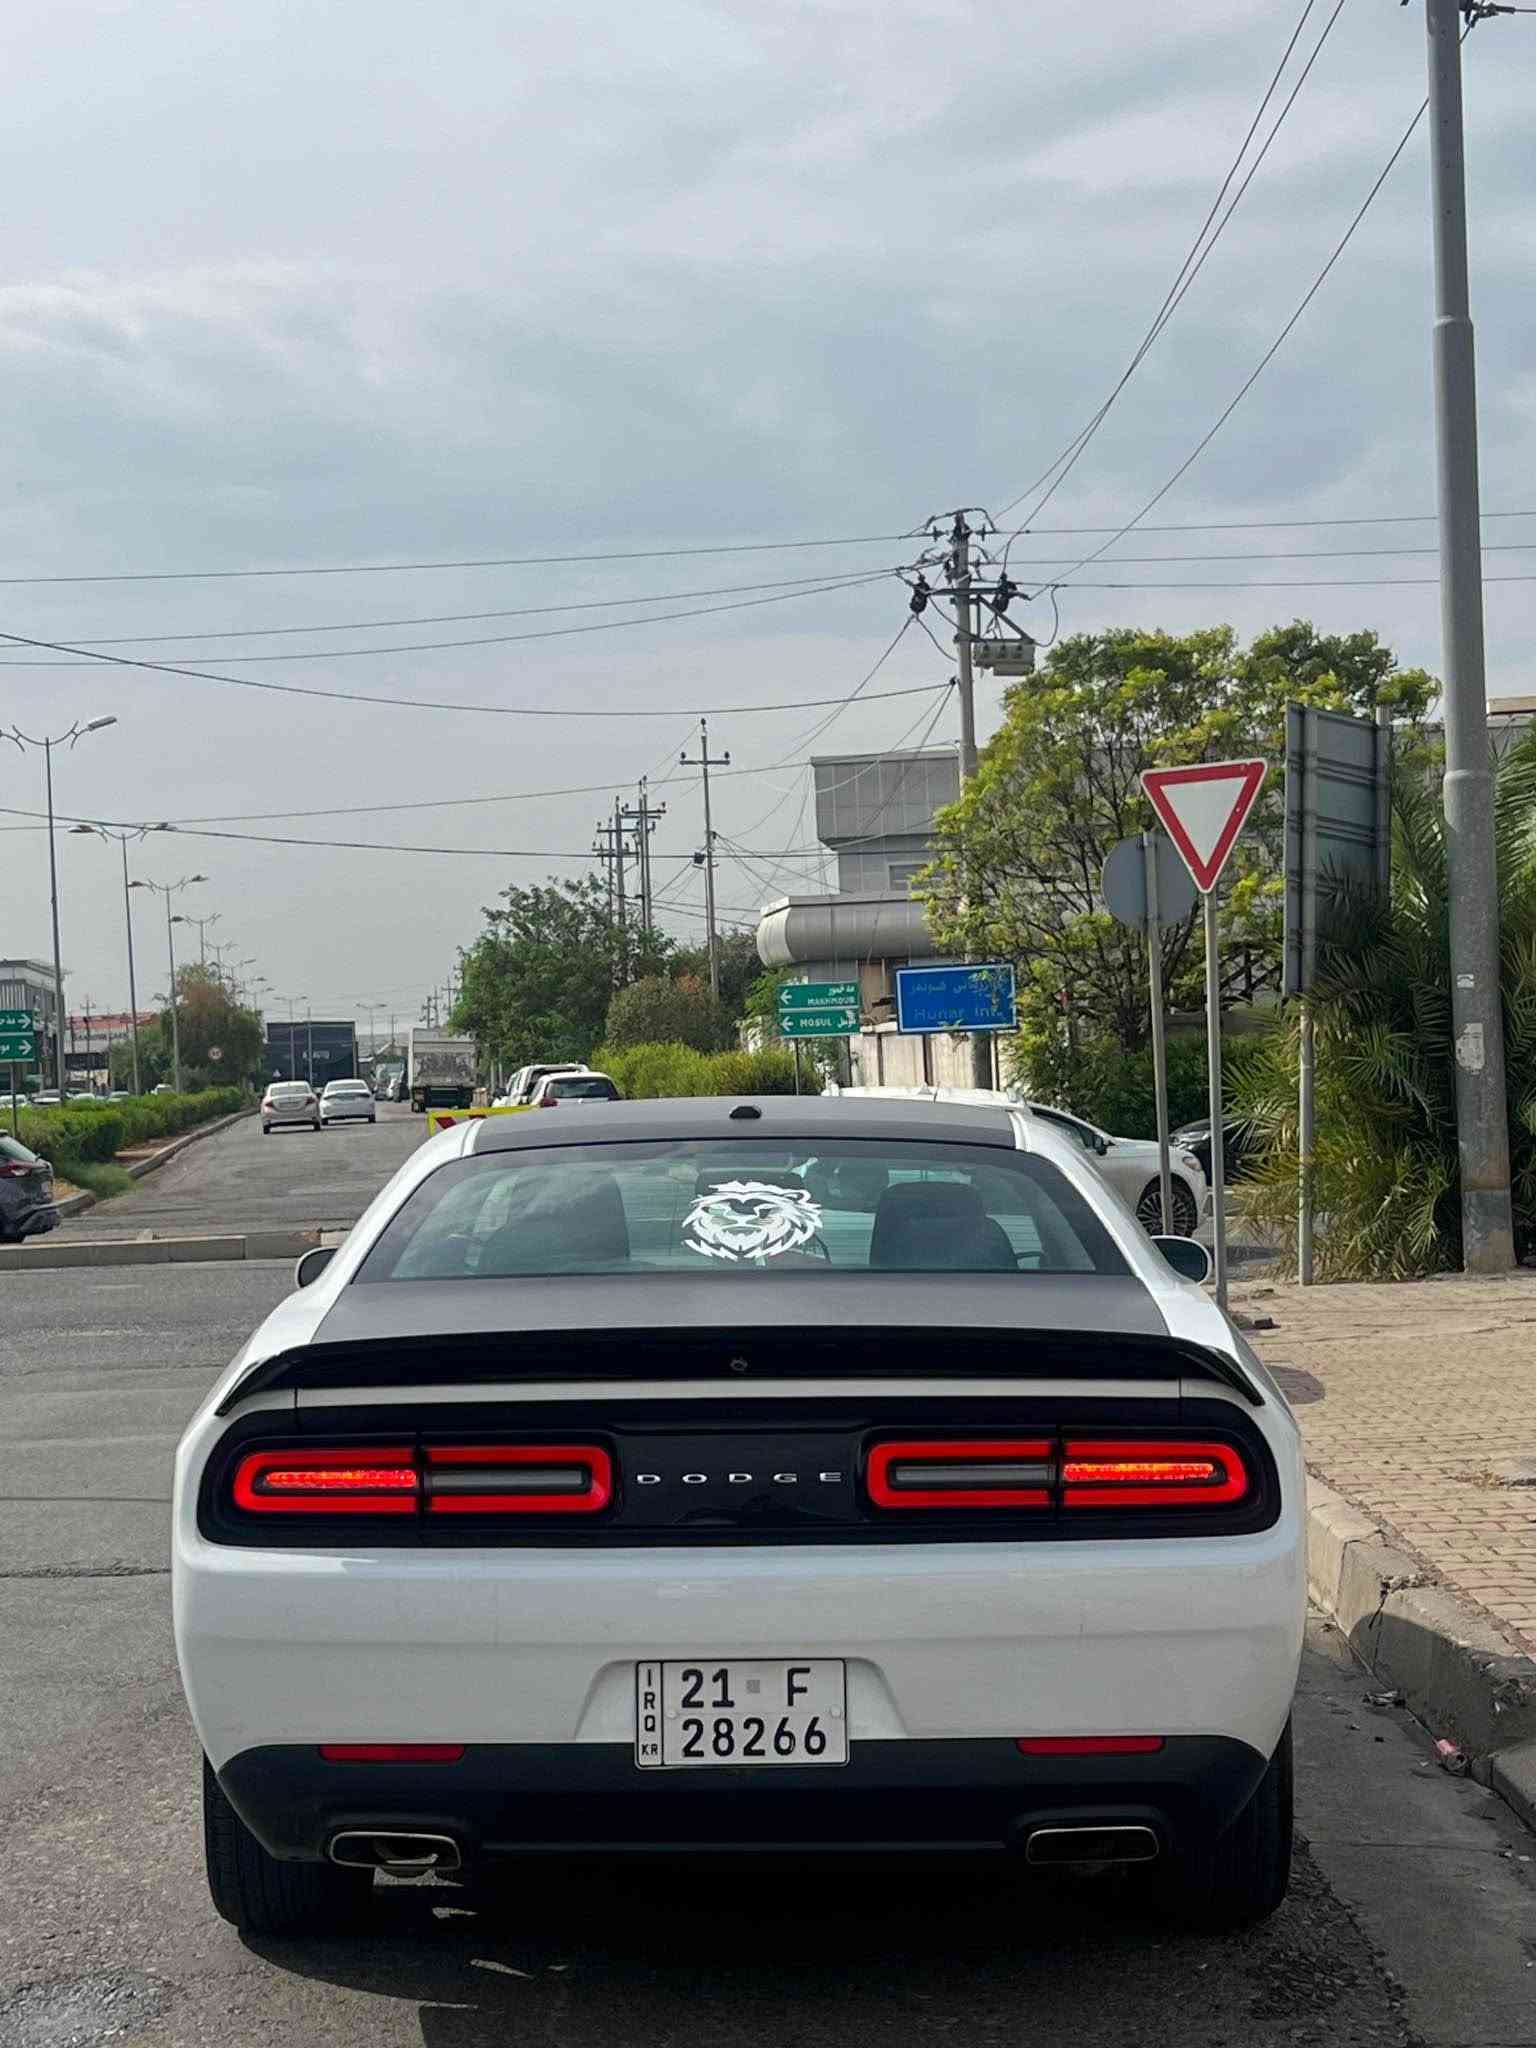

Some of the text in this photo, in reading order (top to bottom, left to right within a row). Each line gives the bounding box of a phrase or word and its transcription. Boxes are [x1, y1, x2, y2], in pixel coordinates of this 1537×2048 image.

[799, 1017, 833, 1027] MOSUL
[636, 1472, 842, 1484] DODGE
[643, 1669, 656, 1732] IRQ
[681, 1667, 811, 1708] 21 F
[682, 1716, 827, 1758] 28266
